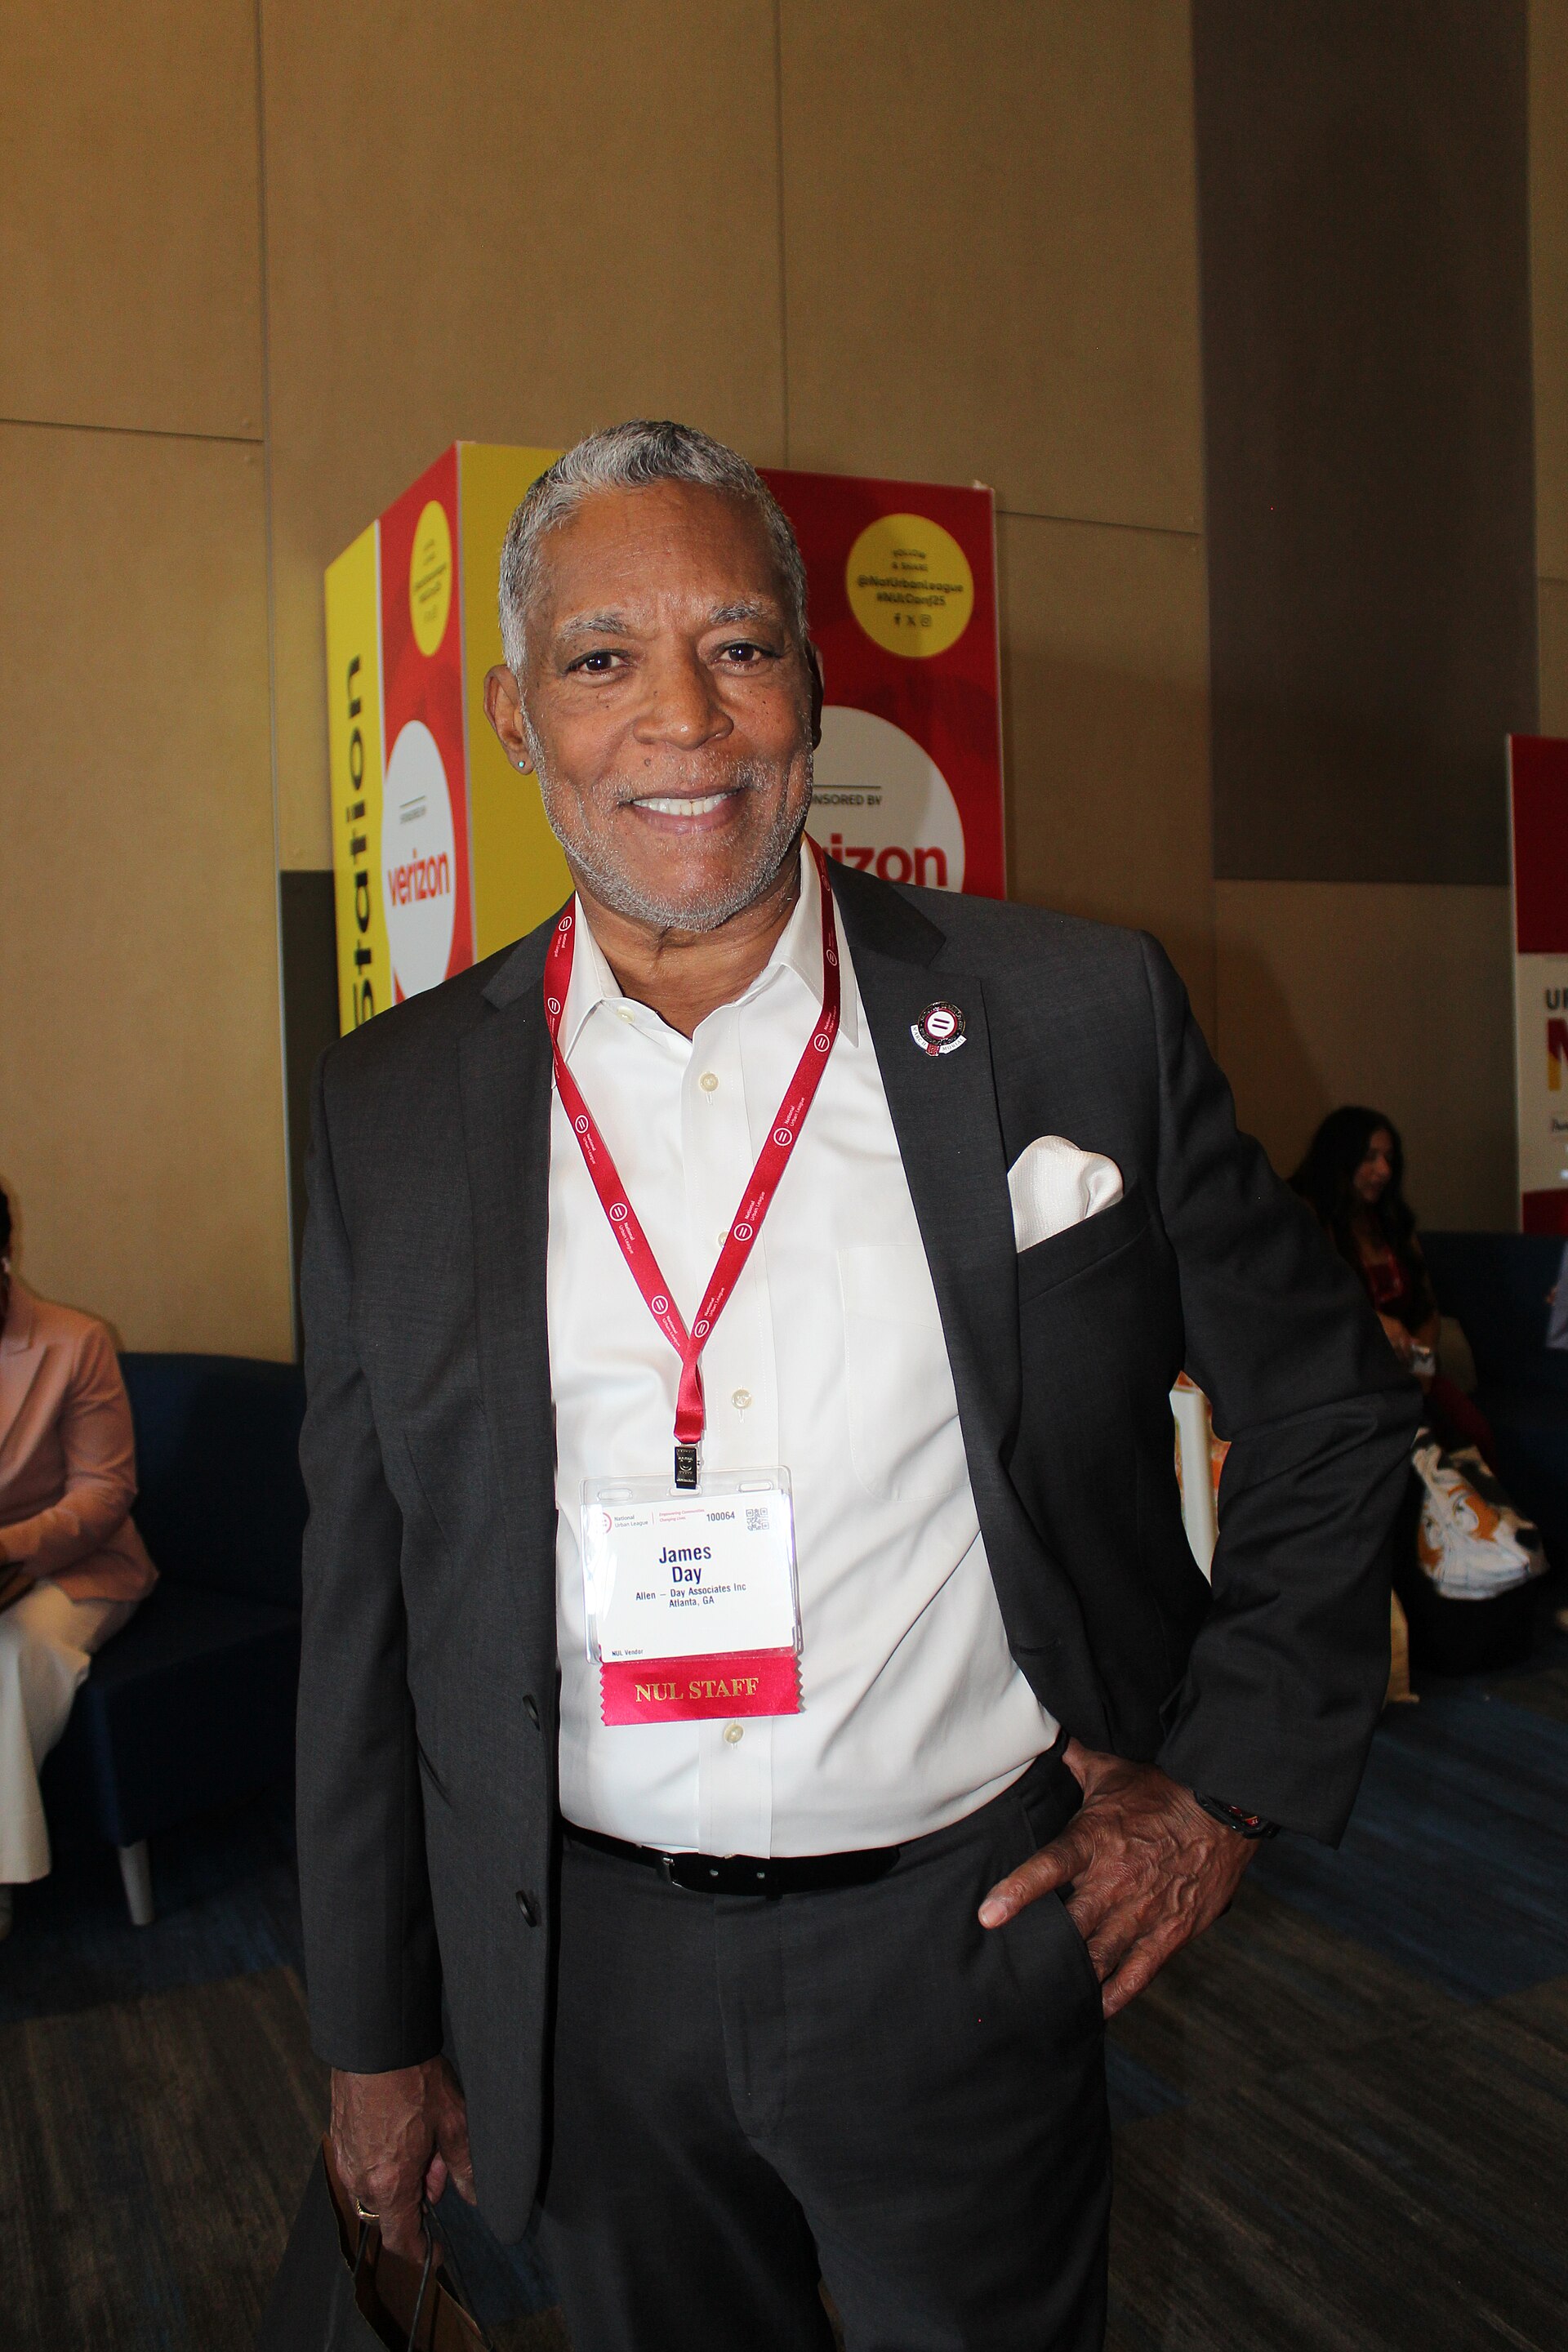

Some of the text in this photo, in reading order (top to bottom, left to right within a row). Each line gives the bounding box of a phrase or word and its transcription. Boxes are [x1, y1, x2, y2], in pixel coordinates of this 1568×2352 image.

[387, 847, 451, 908] verizon
[706, 1511, 735, 1521] 100064
[659, 1545, 712, 1564] James
[672, 1566, 702, 1584] Day
[635, 1592, 657, 1601] Allen
[670, 1588, 685, 1598] Day
[688, 1585, 732, 1596] Associates
[733, 1583, 747, 1592] Inc
[669, 1596, 715, 1608] Atlanta, GA
[624, 1648, 644, 1656] Vendor
[635, 1677, 760, 1703] NUL STAFF
